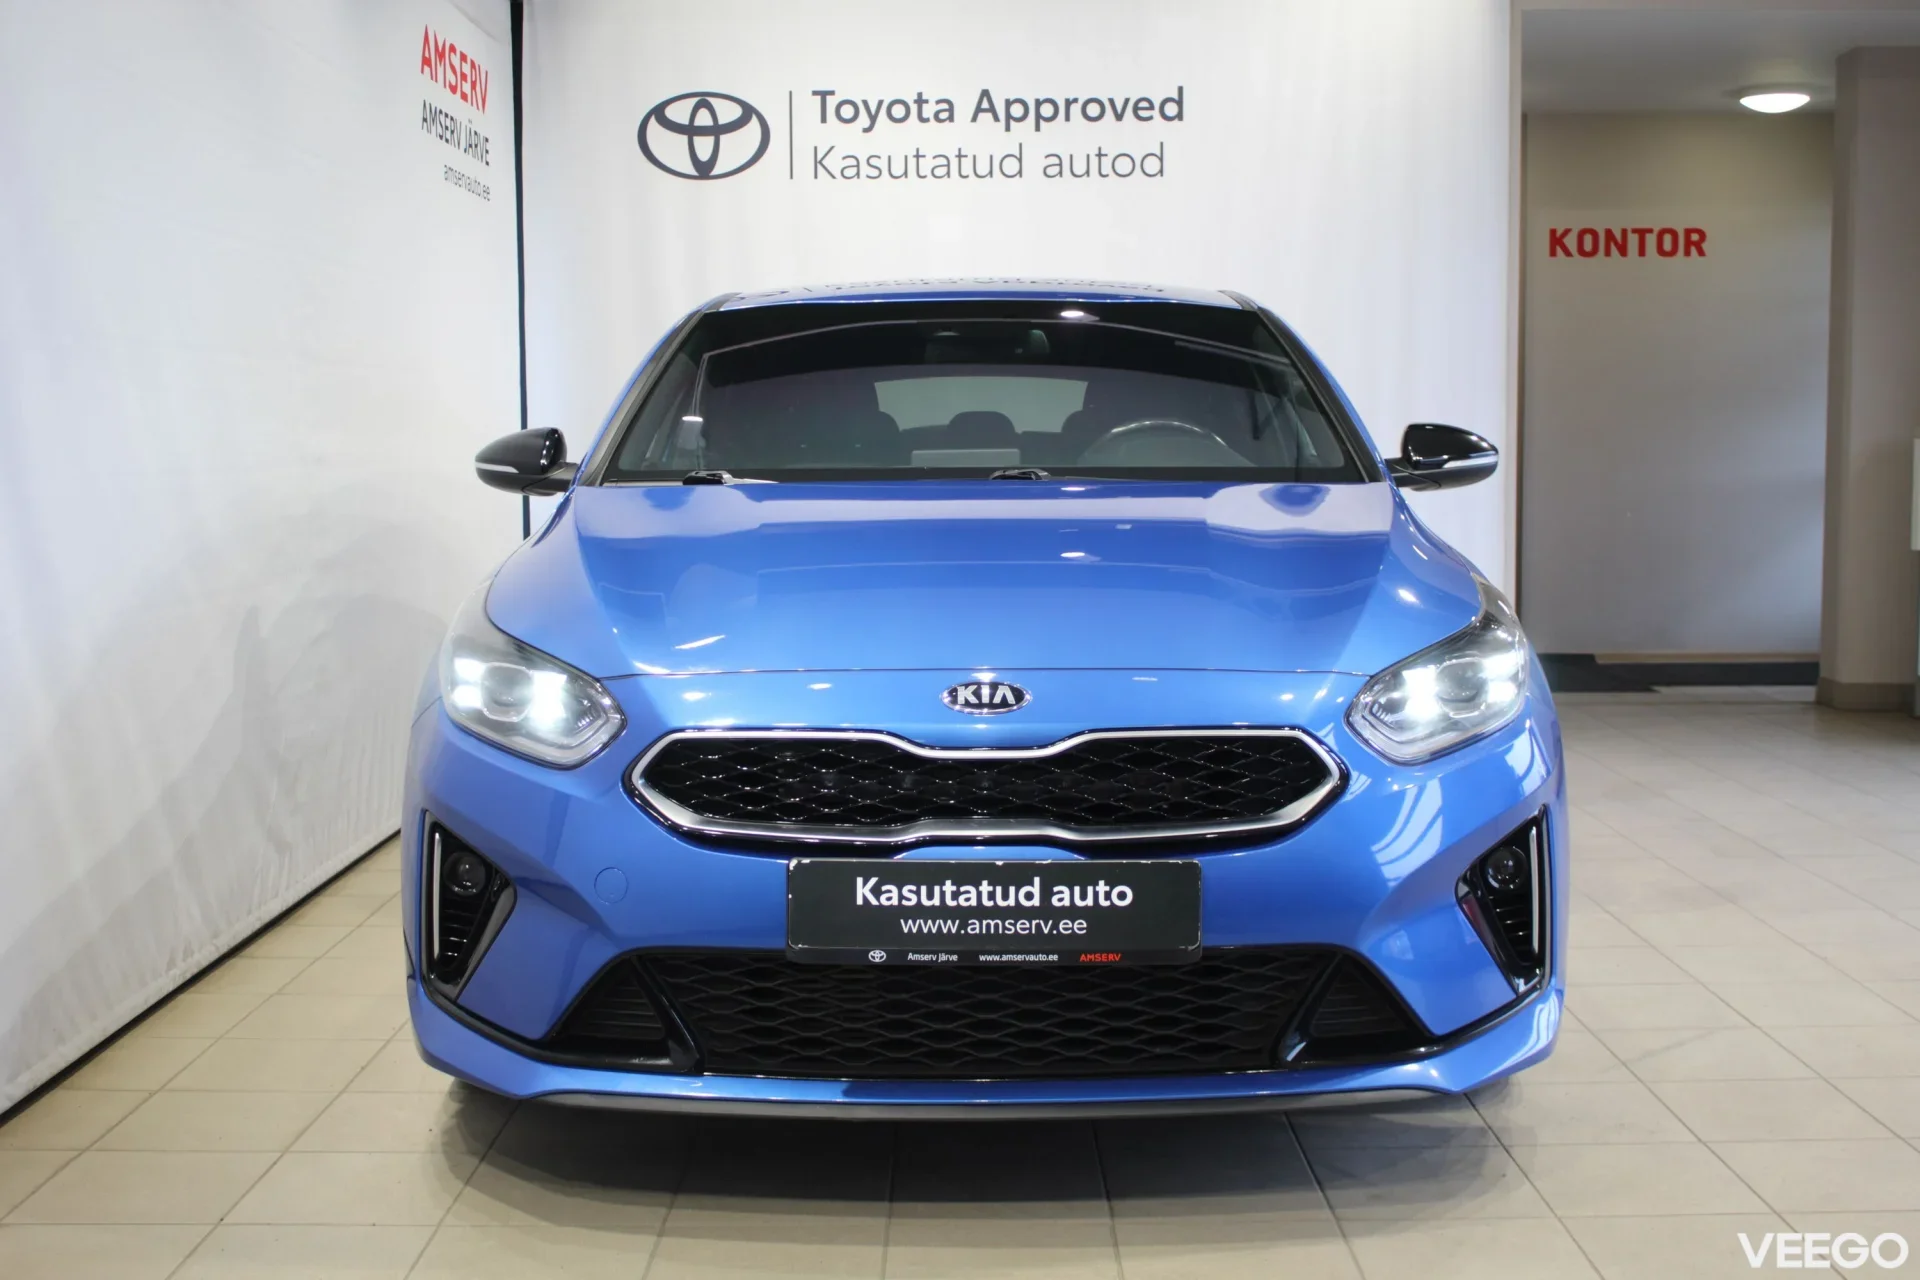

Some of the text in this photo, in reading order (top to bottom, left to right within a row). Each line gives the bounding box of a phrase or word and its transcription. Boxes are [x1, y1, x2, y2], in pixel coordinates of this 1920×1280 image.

[420, 23, 488, 115] AMSERV
[812, 85, 1185, 133] Toyota Approved
[421, 99, 490, 166] AMSERV JÄRVE
[813, 141, 1165, 180] Kasutatud autod
[443, 164, 490, 202] amservauto.ee
[1549, 227, 1707, 258] KONTOR
[957, 684, 1016, 705] KIA
[856, 876, 1133, 908] Kasutatud auto
[900, 917, 1088, 935] www.amserv.ee
[907, 952, 1122, 963] Amserv Järve www.amservauto.ee AMSERV
